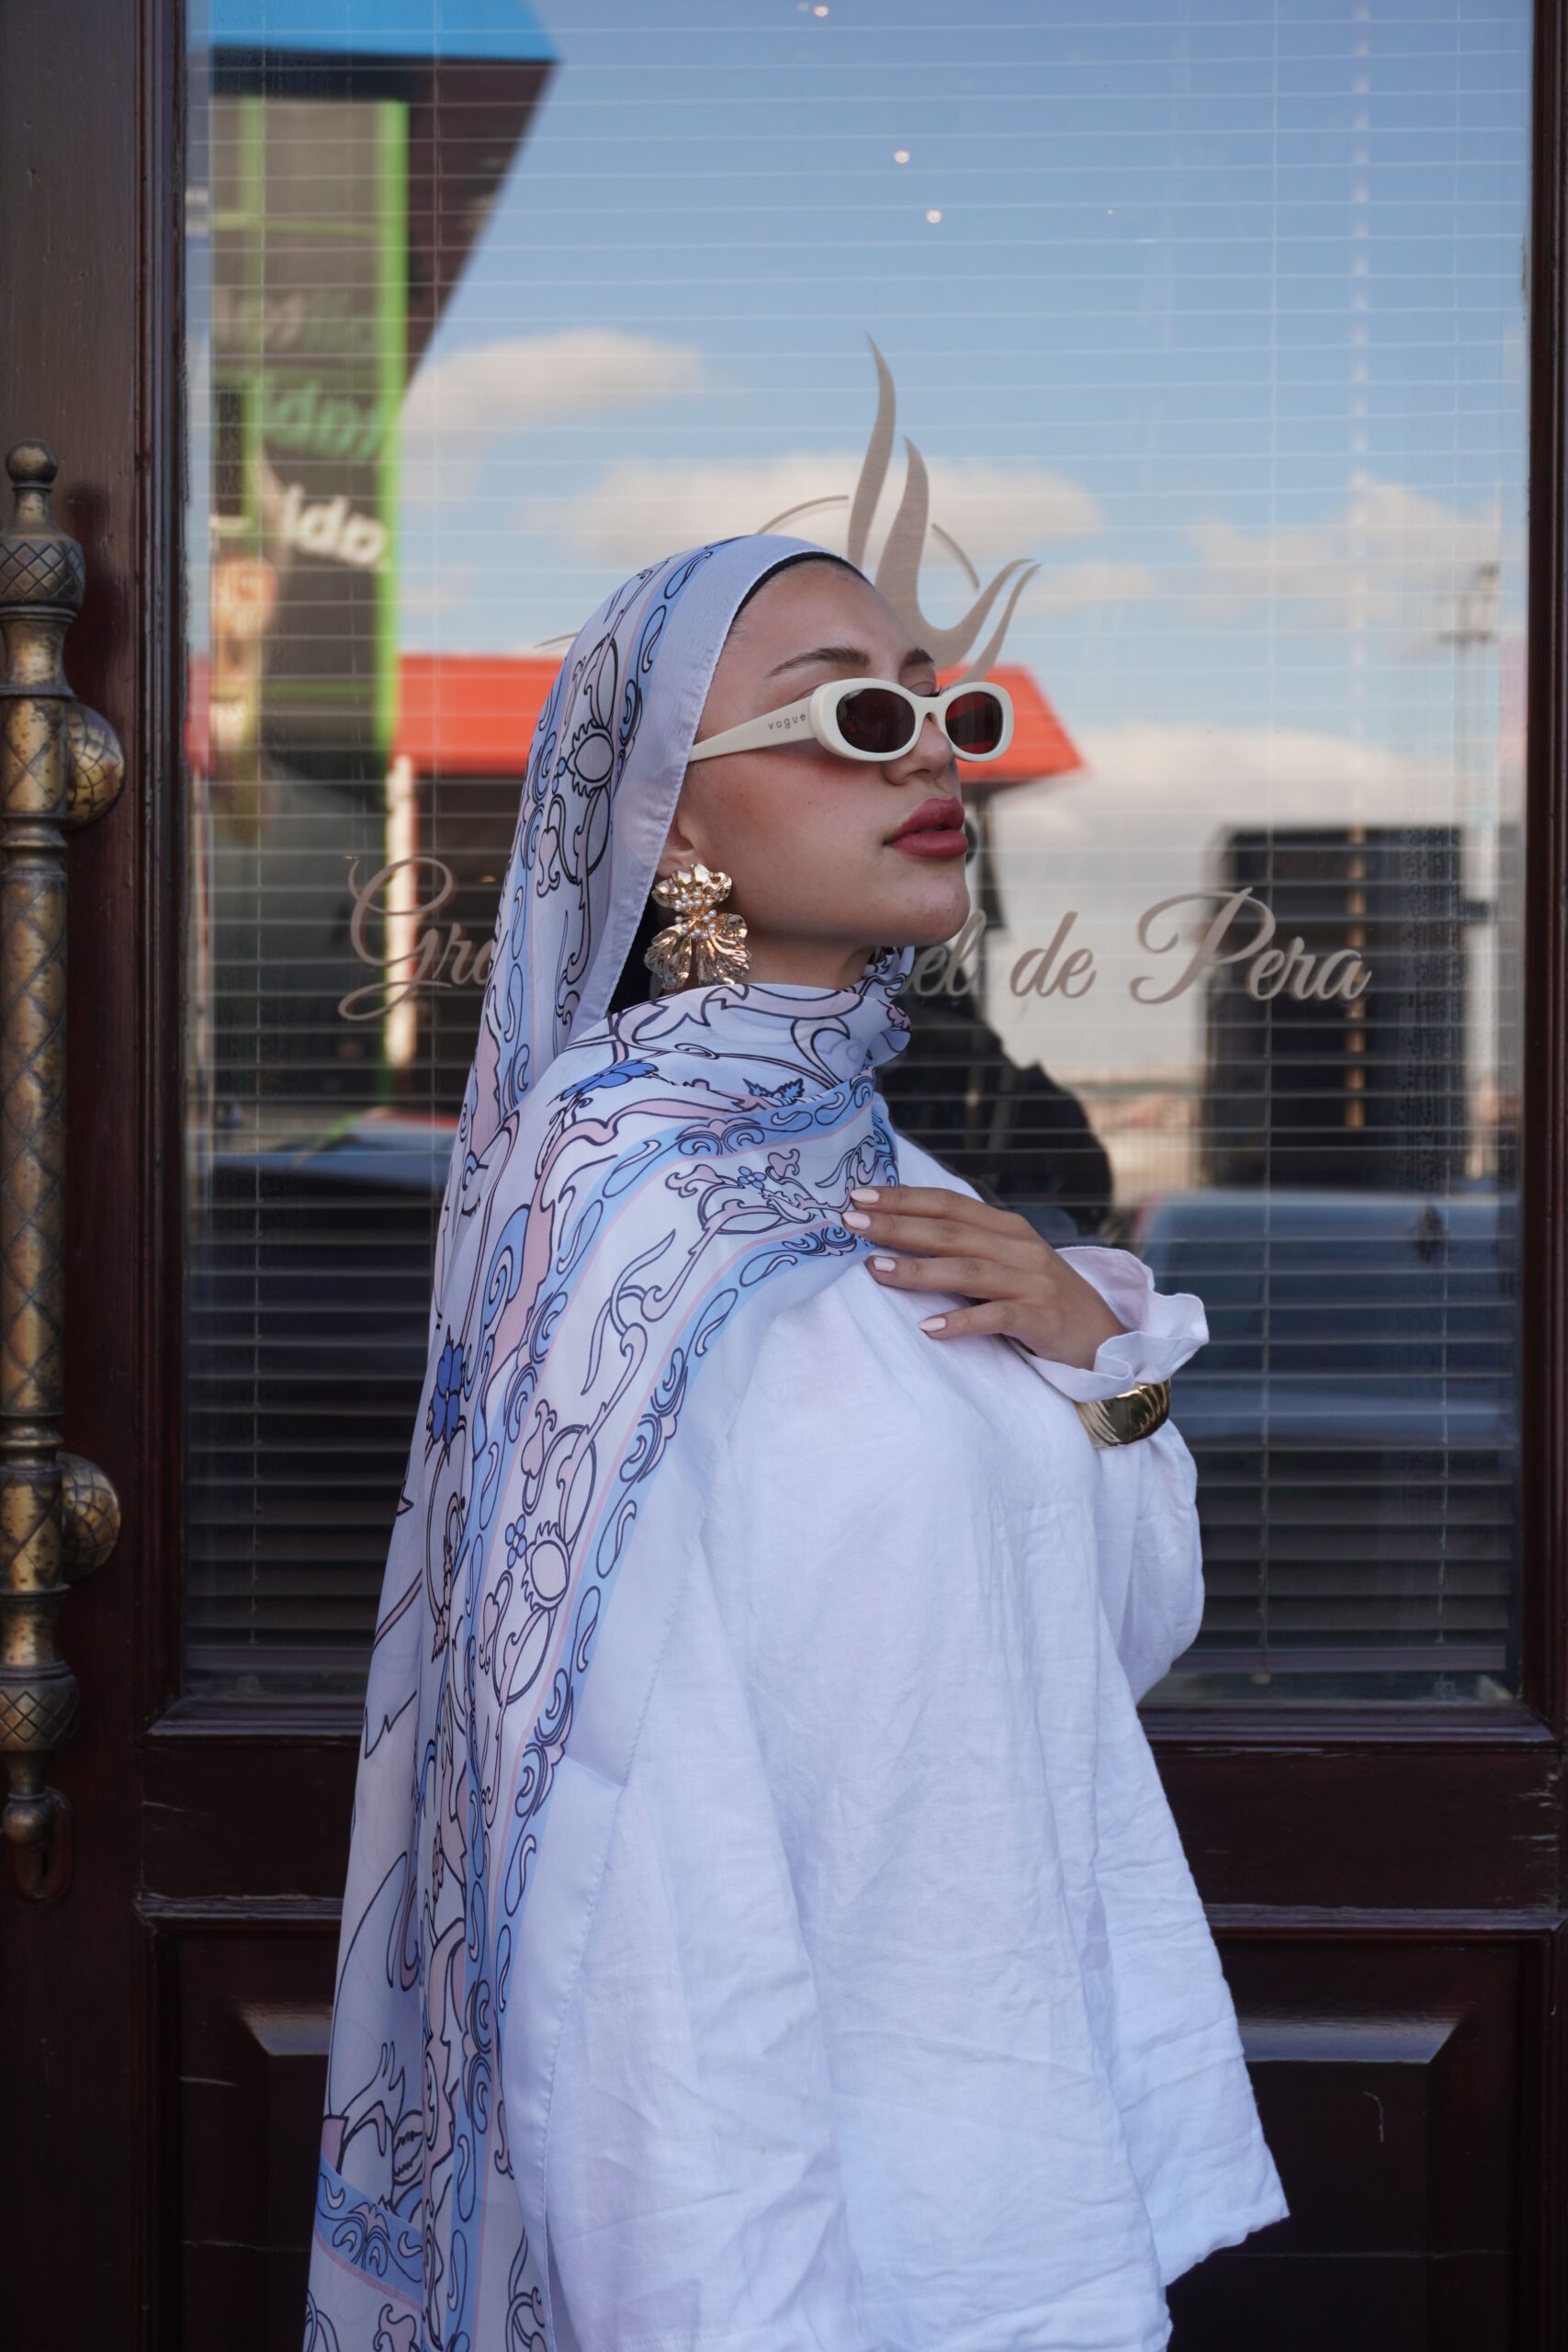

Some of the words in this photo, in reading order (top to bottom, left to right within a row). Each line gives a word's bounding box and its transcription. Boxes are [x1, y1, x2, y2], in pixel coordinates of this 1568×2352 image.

[768, 713, 807, 729] vogue
[1010, 911, 1097, 998] de
[1129, 887, 1372, 1004] Pera
